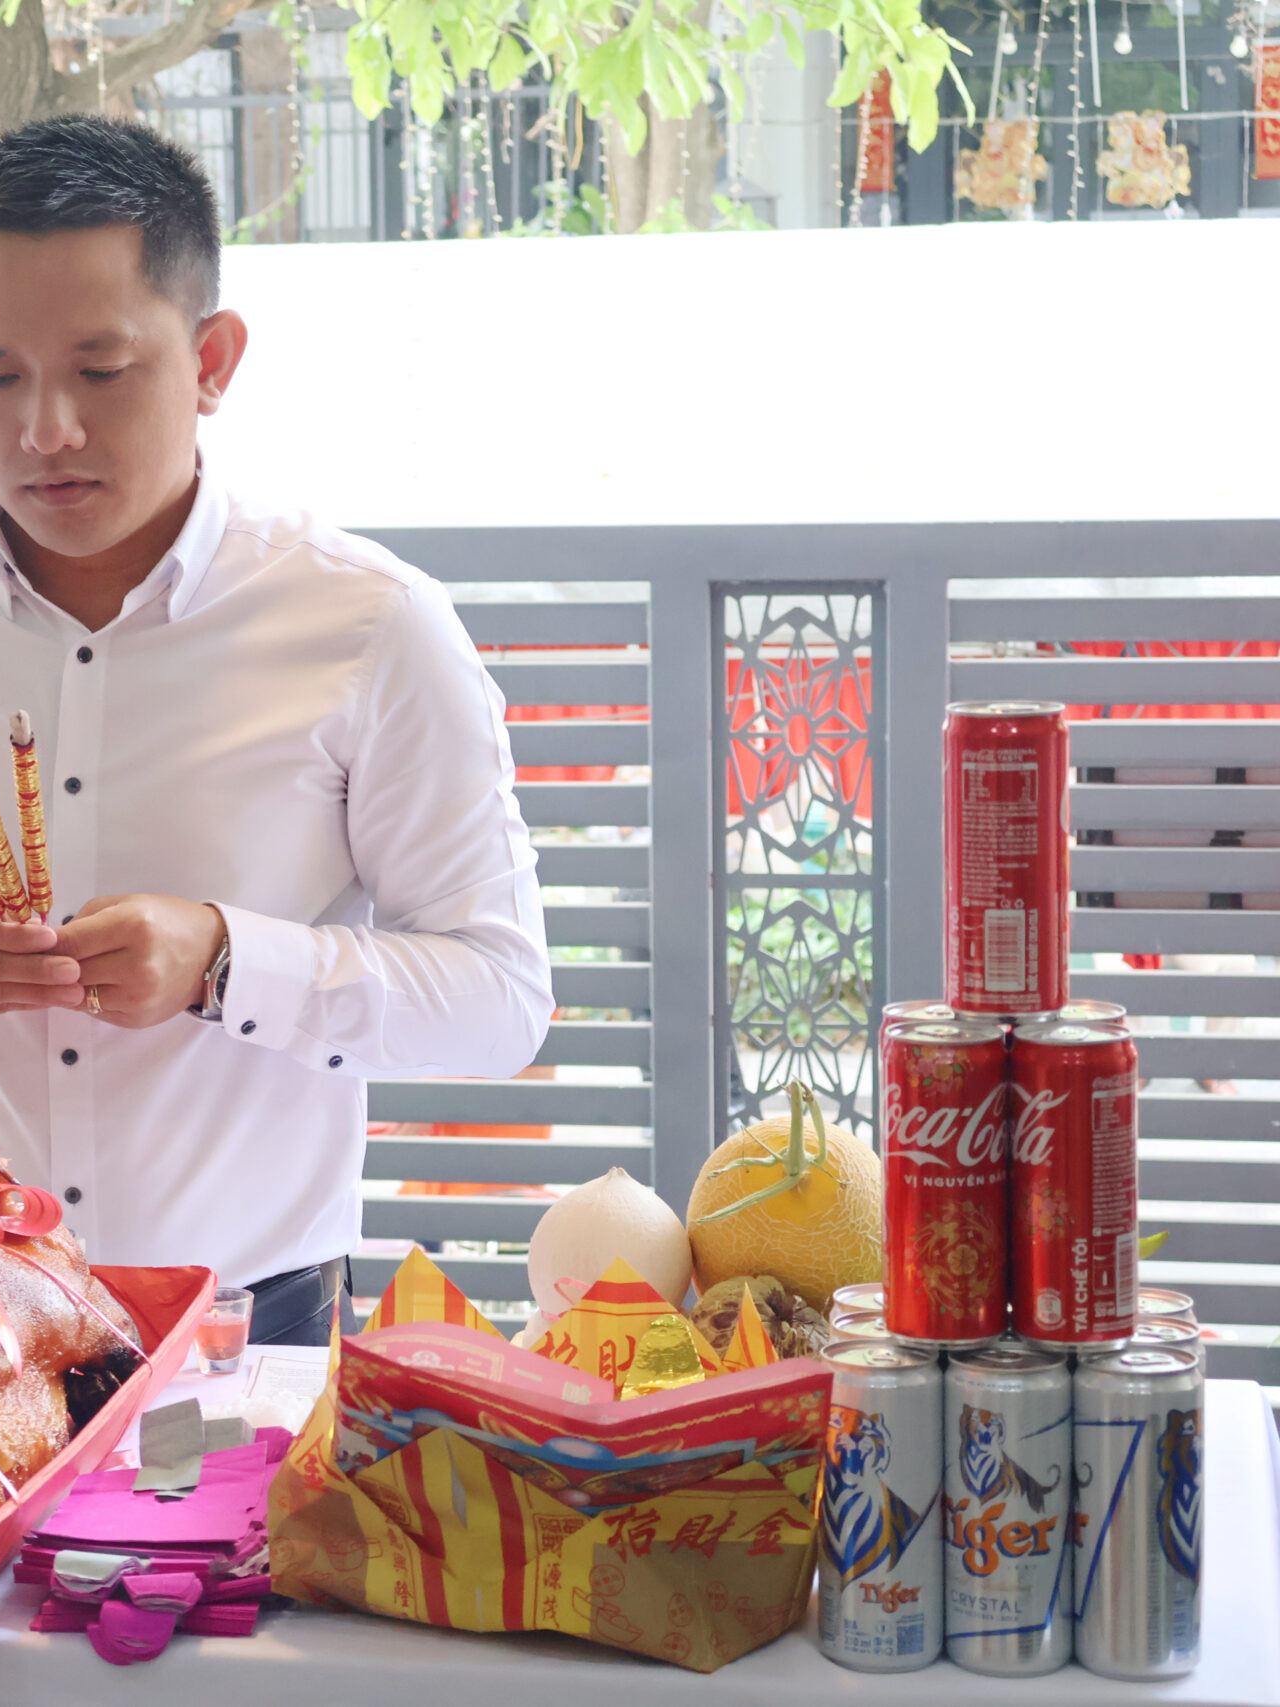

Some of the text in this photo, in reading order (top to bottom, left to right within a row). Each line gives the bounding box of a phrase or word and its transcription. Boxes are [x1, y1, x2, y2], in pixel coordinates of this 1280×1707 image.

[904, 1174, 918, 1189] VỊ
[923, 1172, 985, 1188] NGUYÊN
[1070, 1238, 1088, 1333] TÁI CHẾ TÔI
[858, 1581, 923, 1614] Tiger
[951, 1589, 1023, 1614] CRYSTAL
